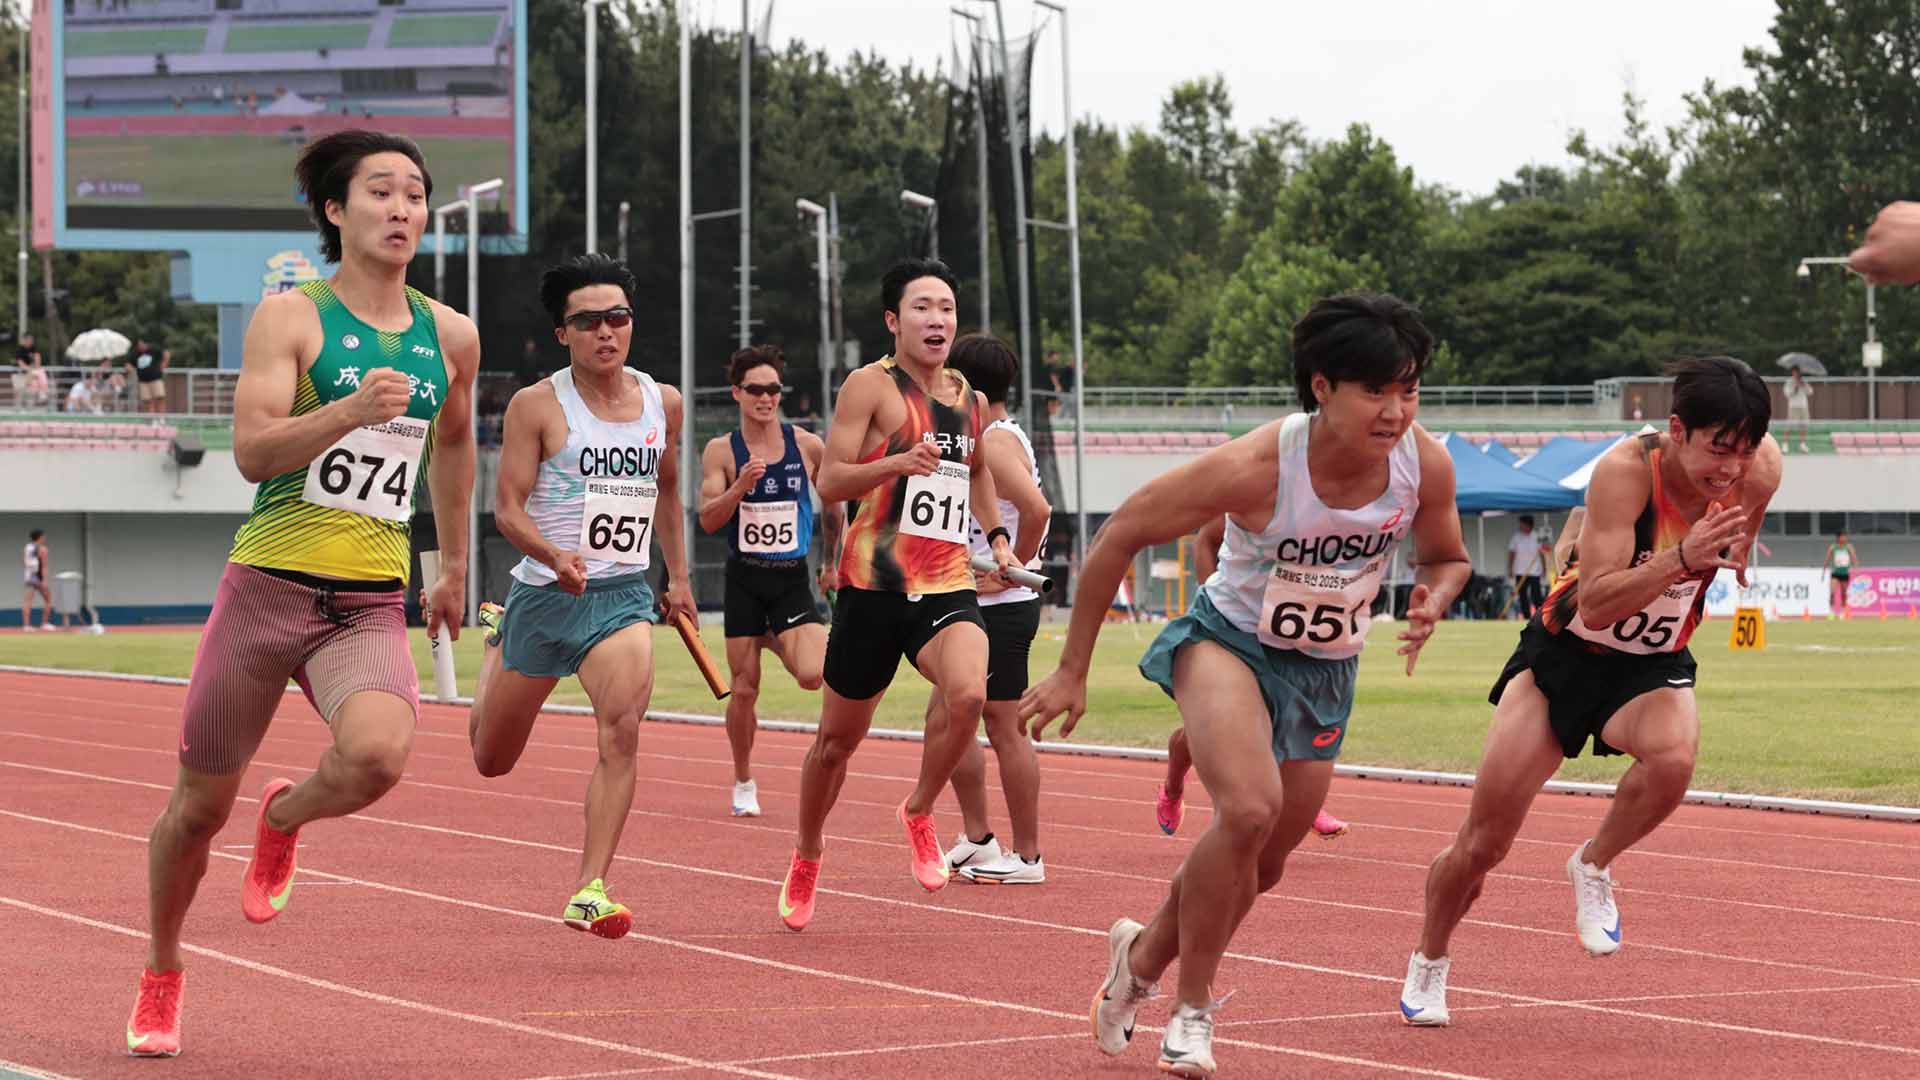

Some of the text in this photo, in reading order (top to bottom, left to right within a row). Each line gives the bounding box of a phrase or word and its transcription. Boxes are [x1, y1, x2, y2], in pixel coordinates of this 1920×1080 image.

[319, 447, 408, 507] 674
[910, 490, 966, 534] 611
[588, 513, 650, 553] 657
[744, 522, 793, 546] 695
[1319, 574, 1340, 589] 2025
[1613, 611, 1680, 648] 05
[1736, 616, 1757, 647] 50
